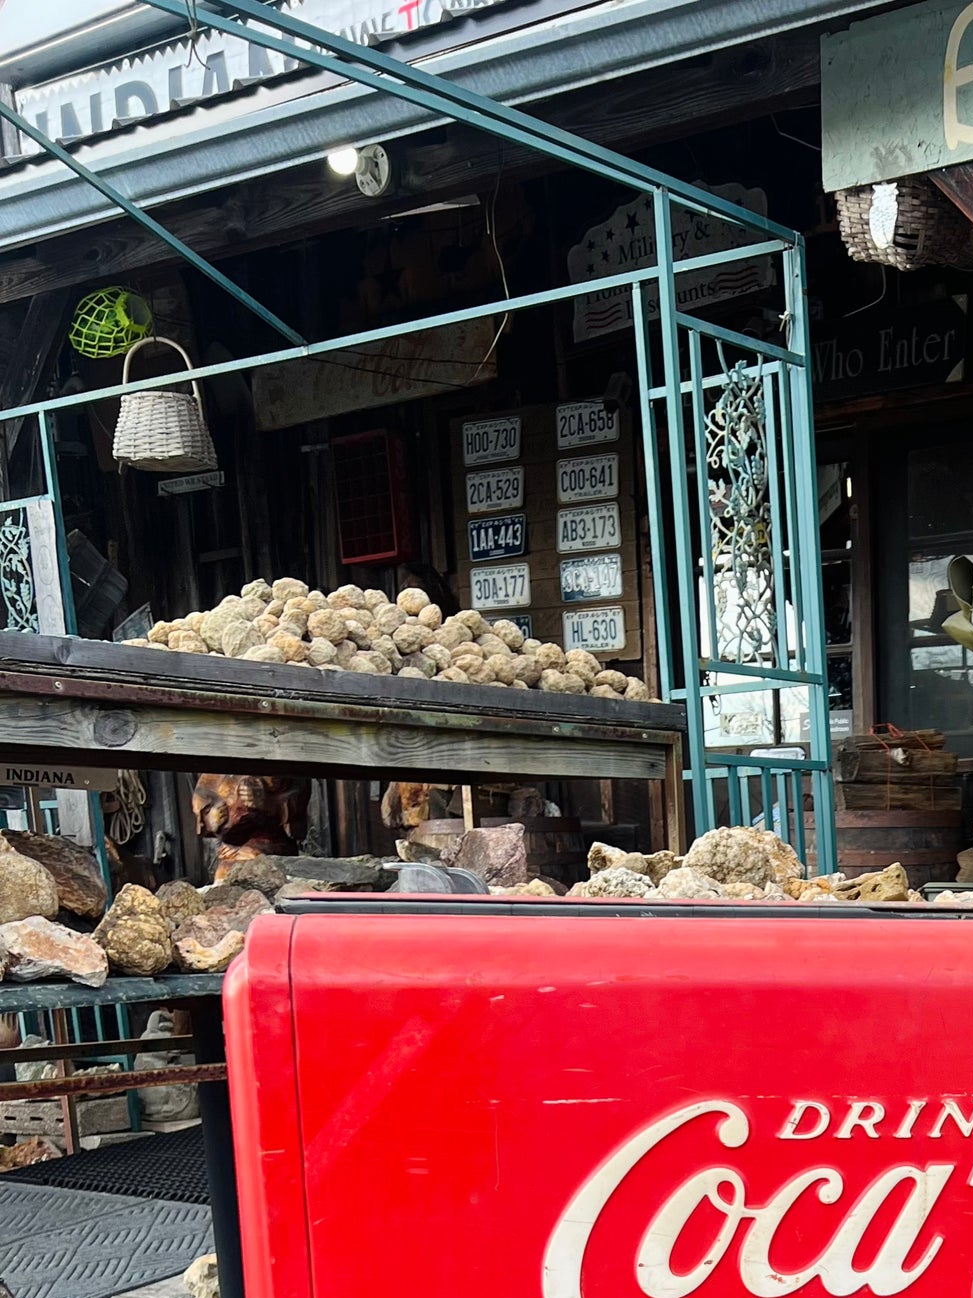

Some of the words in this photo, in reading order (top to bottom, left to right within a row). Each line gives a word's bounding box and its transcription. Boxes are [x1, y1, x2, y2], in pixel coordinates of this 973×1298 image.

[618, 230, 690, 266] Miliry
[812, 335, 865, 385] Who
[878, 325, 957, 374] Enter
[6, 768, 75, 785] INDIANA
